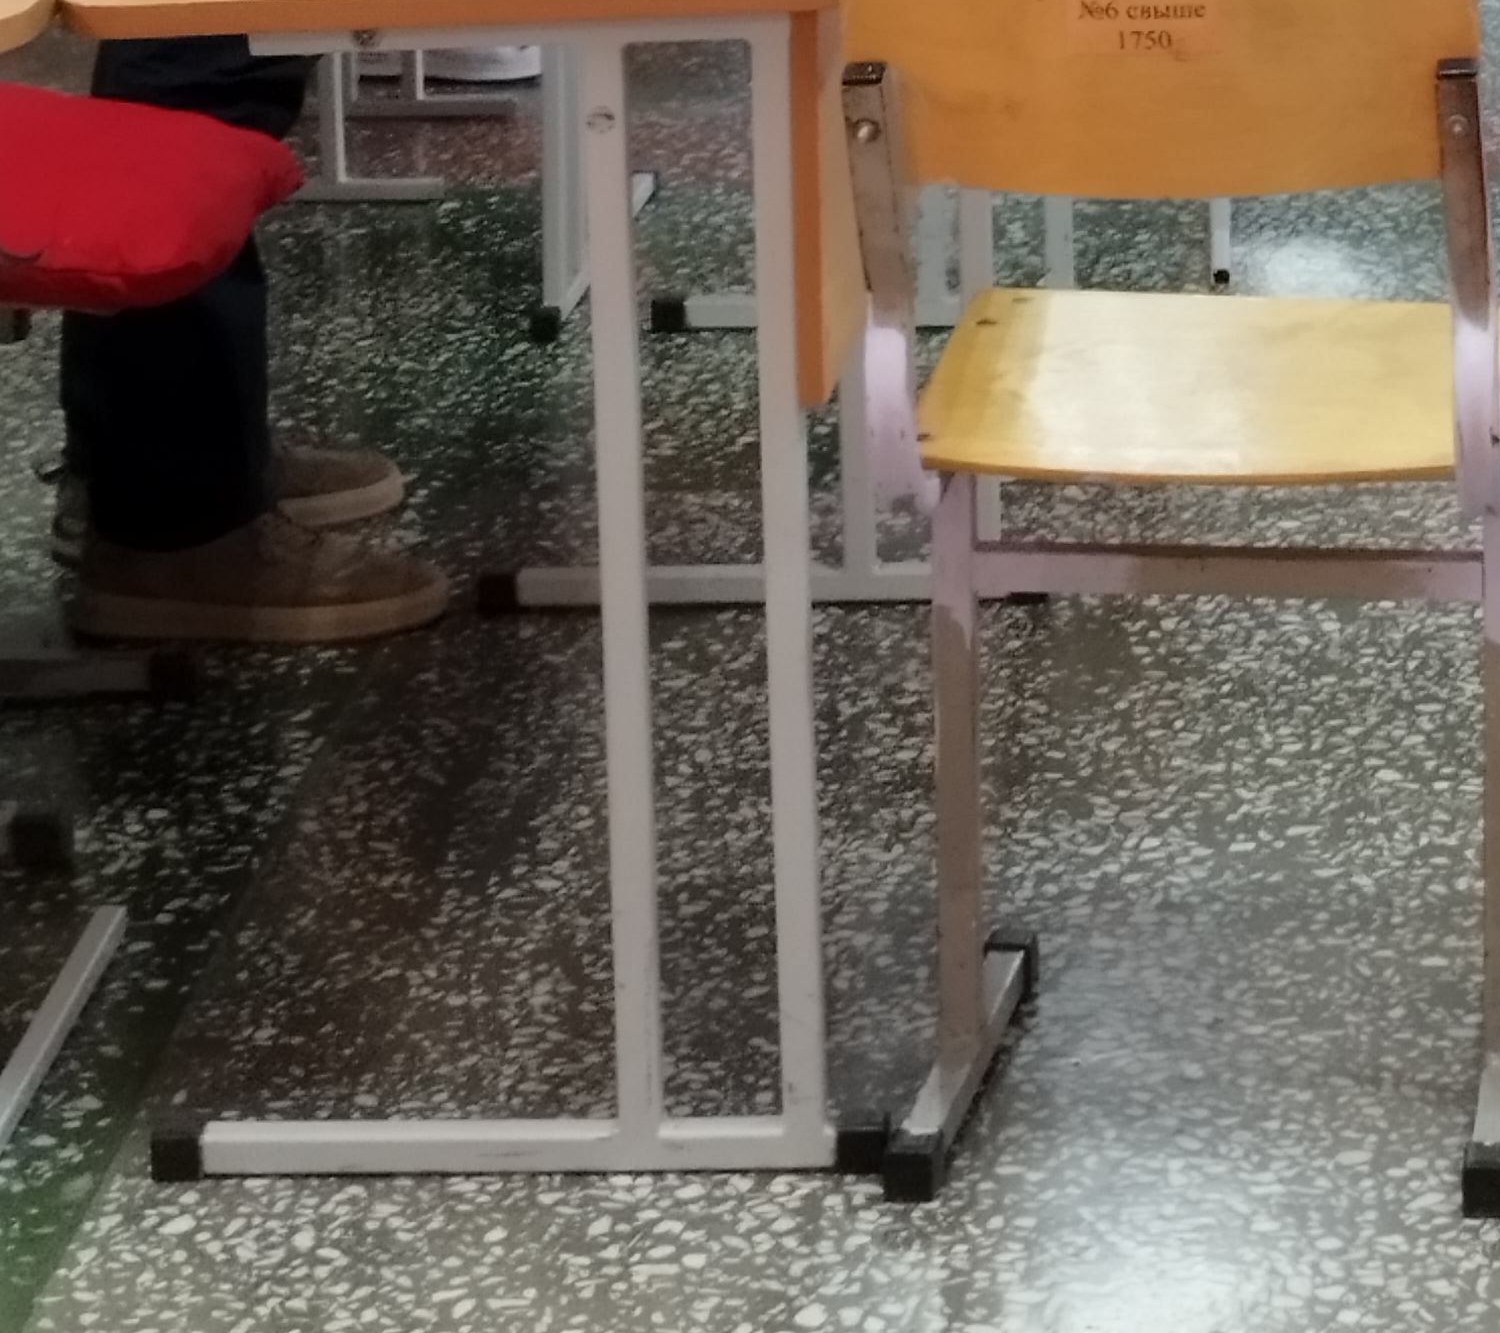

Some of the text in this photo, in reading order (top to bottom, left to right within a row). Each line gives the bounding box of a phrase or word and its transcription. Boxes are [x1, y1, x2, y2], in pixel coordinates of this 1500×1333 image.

[1079, 0, 1206, 20] №6 свыше
[1118, 30, 1173, 50] 1750
